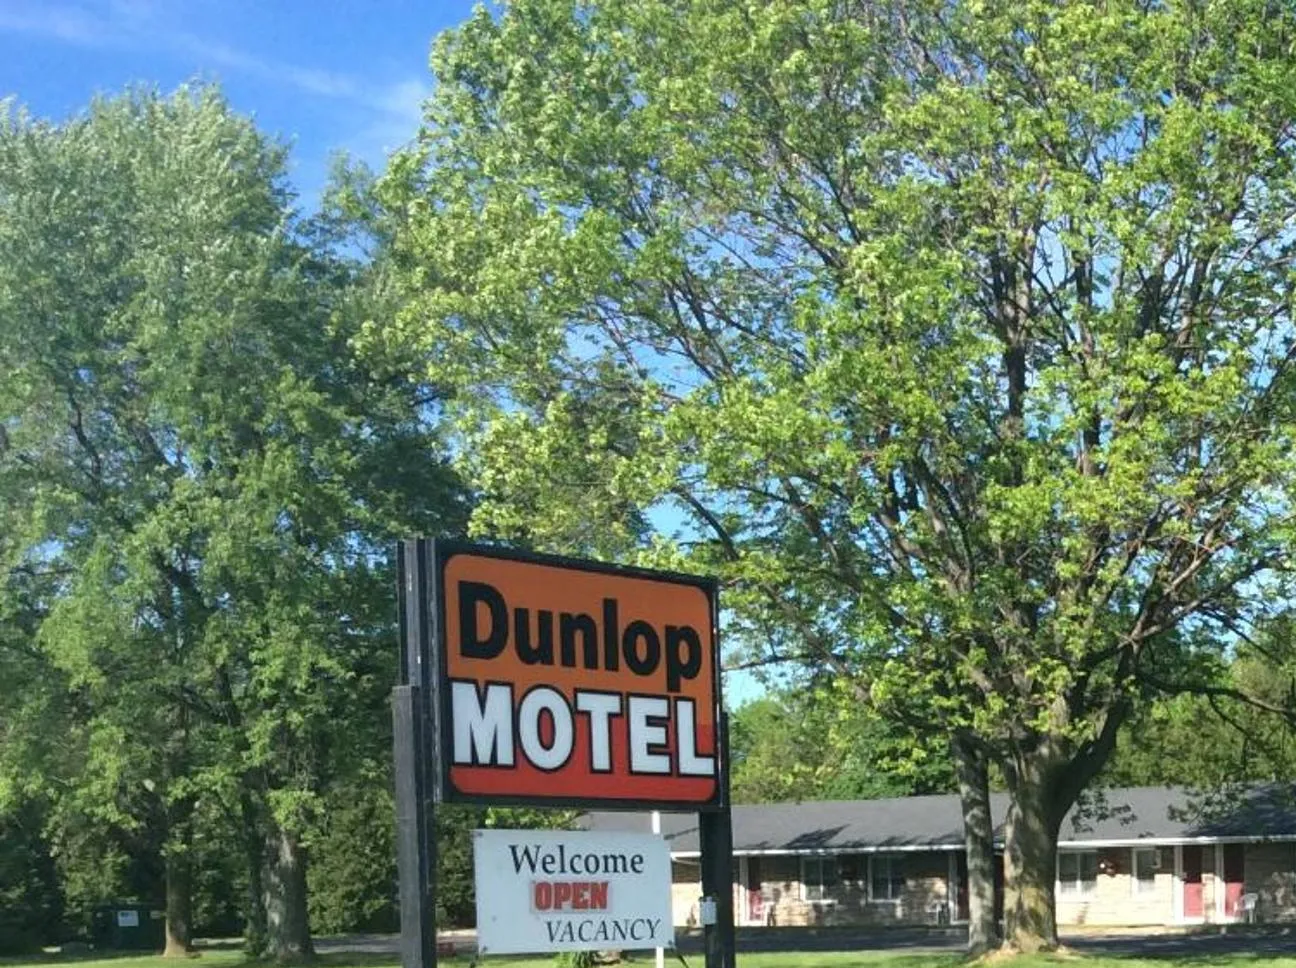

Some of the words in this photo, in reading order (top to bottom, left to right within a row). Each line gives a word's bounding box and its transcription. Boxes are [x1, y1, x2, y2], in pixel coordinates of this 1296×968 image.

[457, 580, 701, 692] Dunlop
[451, 680, 716, 776] MOTEL
[509, 844, 644, 874] Welcome
[533, 881, 608, 911] OPEN
[545, 918, 661, 944] VACANCY
